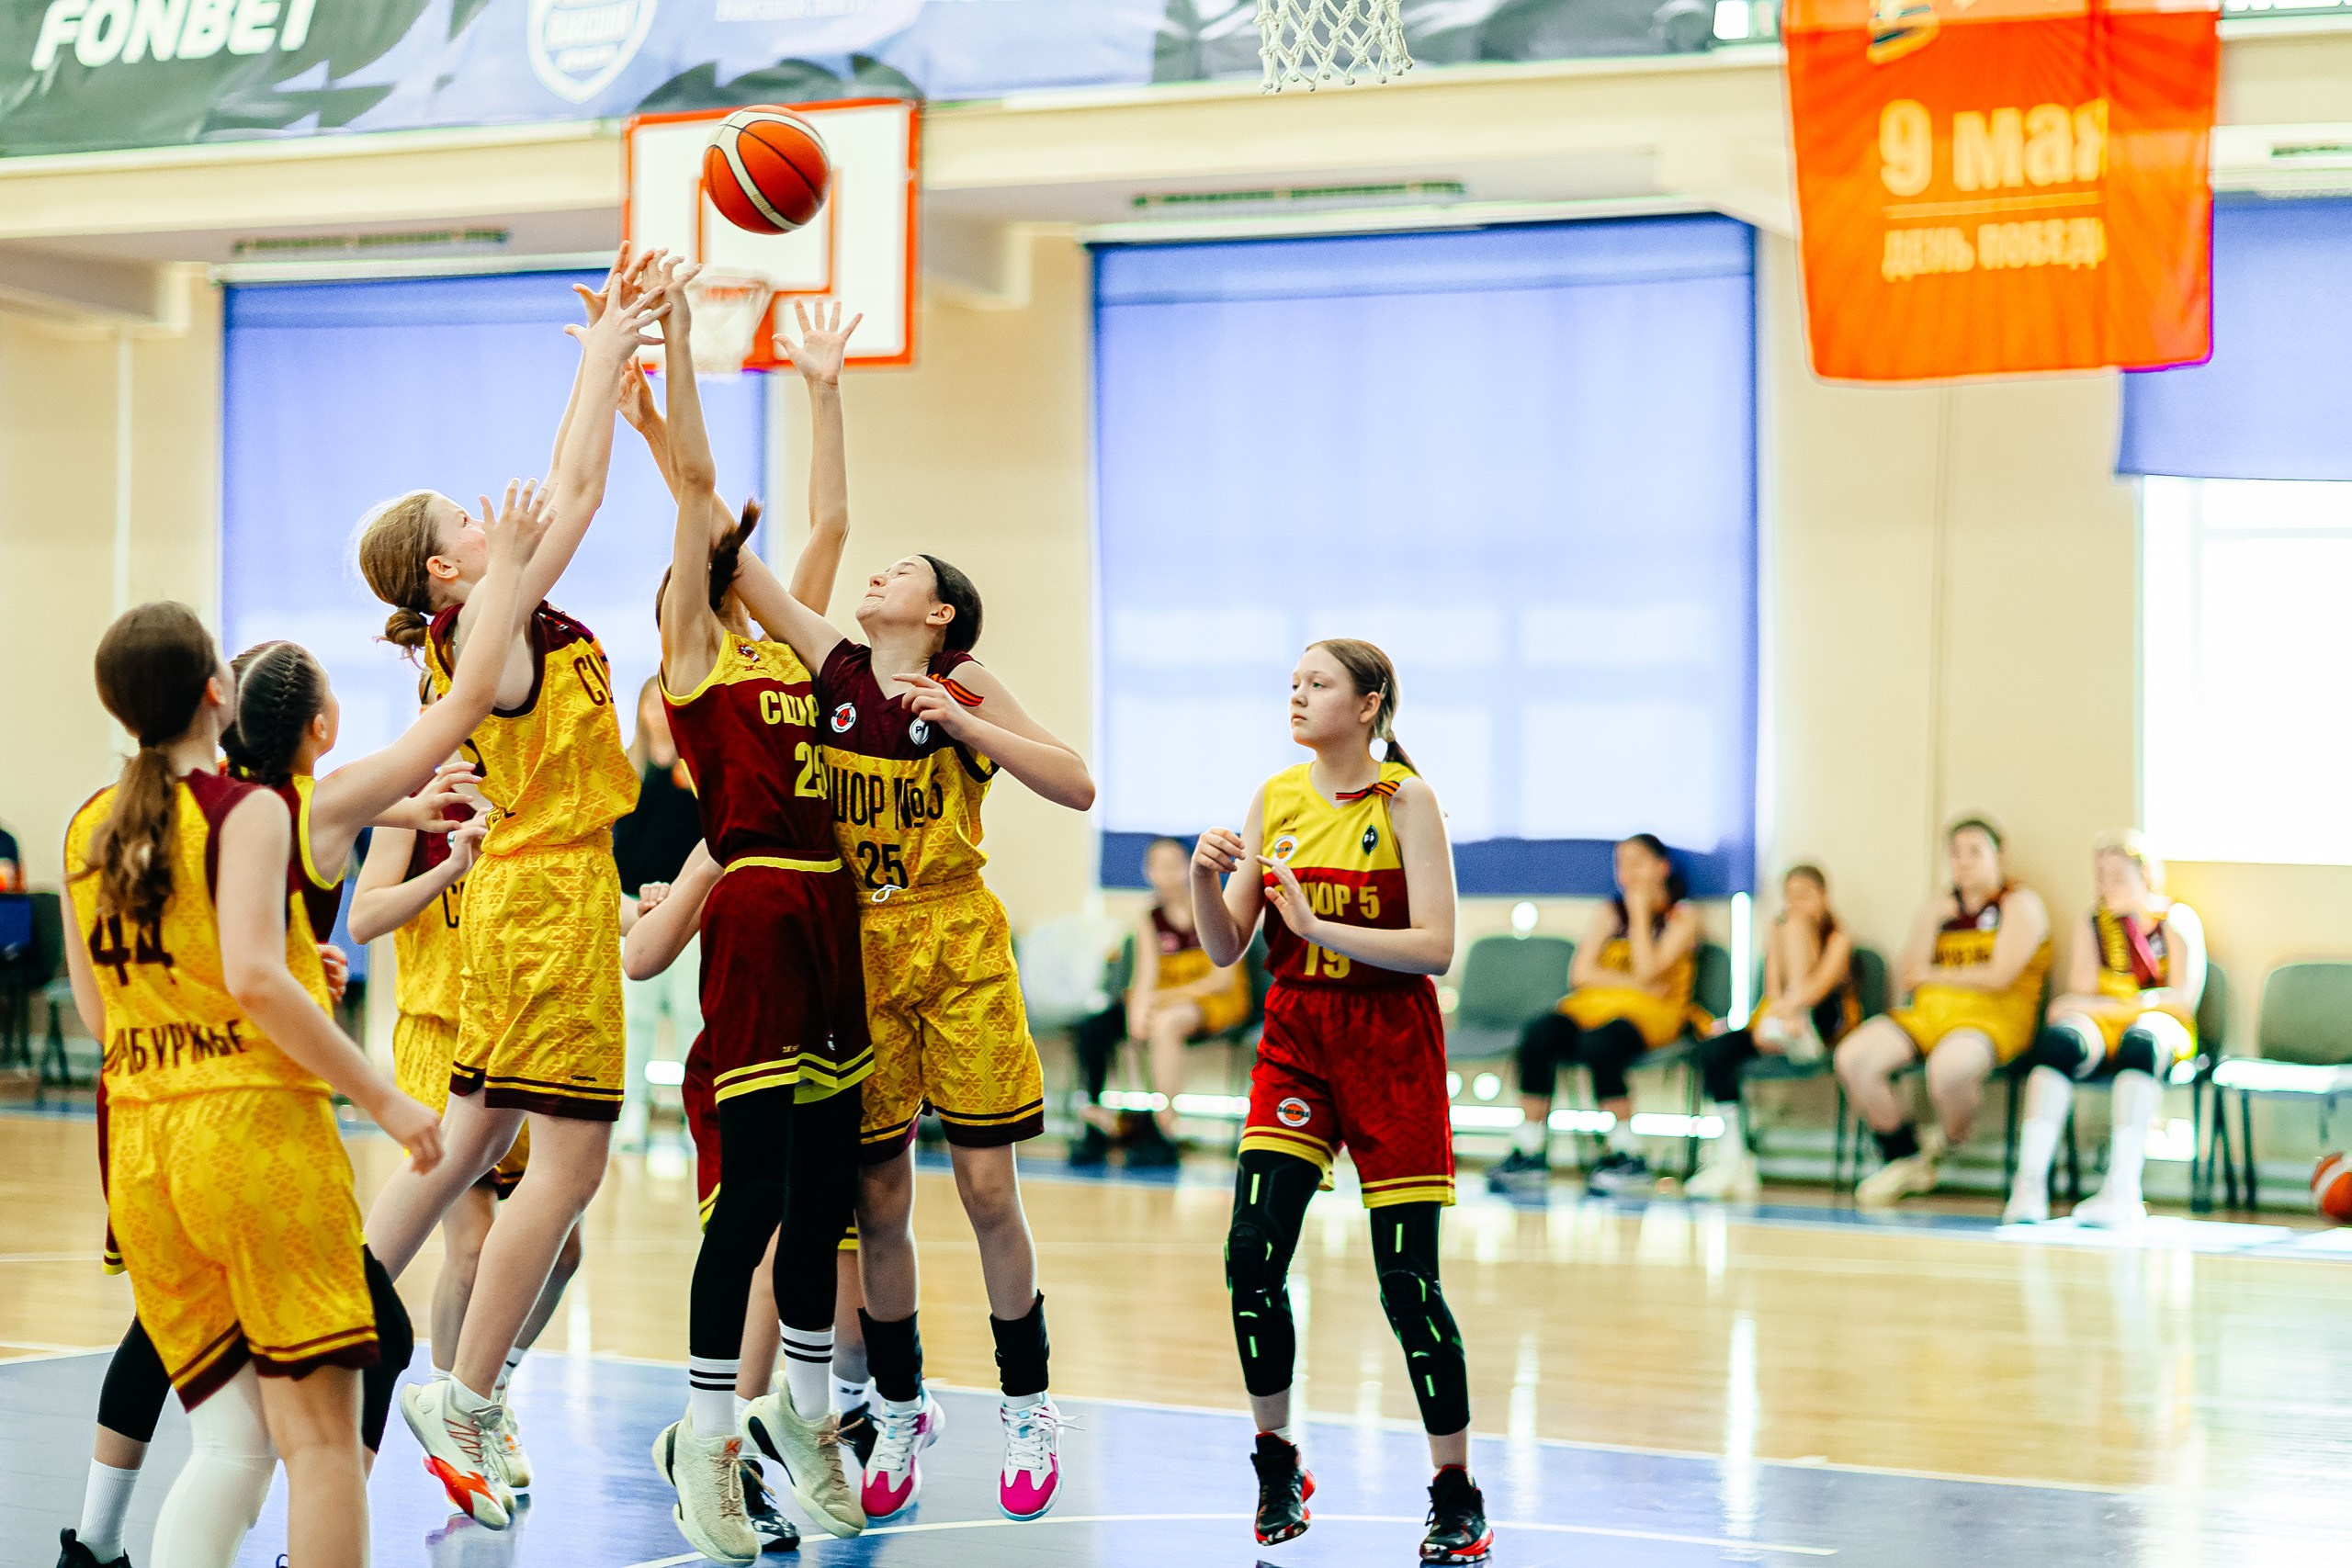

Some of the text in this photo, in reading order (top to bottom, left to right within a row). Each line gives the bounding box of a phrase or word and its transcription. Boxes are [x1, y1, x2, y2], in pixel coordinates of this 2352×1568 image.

[30, 0, 318, 71] FONBET
[1879, 98, 1932, 197] 9
[1882, 226, 1975, 283] ДЕНЬ
[857, 840, 909, 890] 25
[1359, 886, 1380, 919] 5
